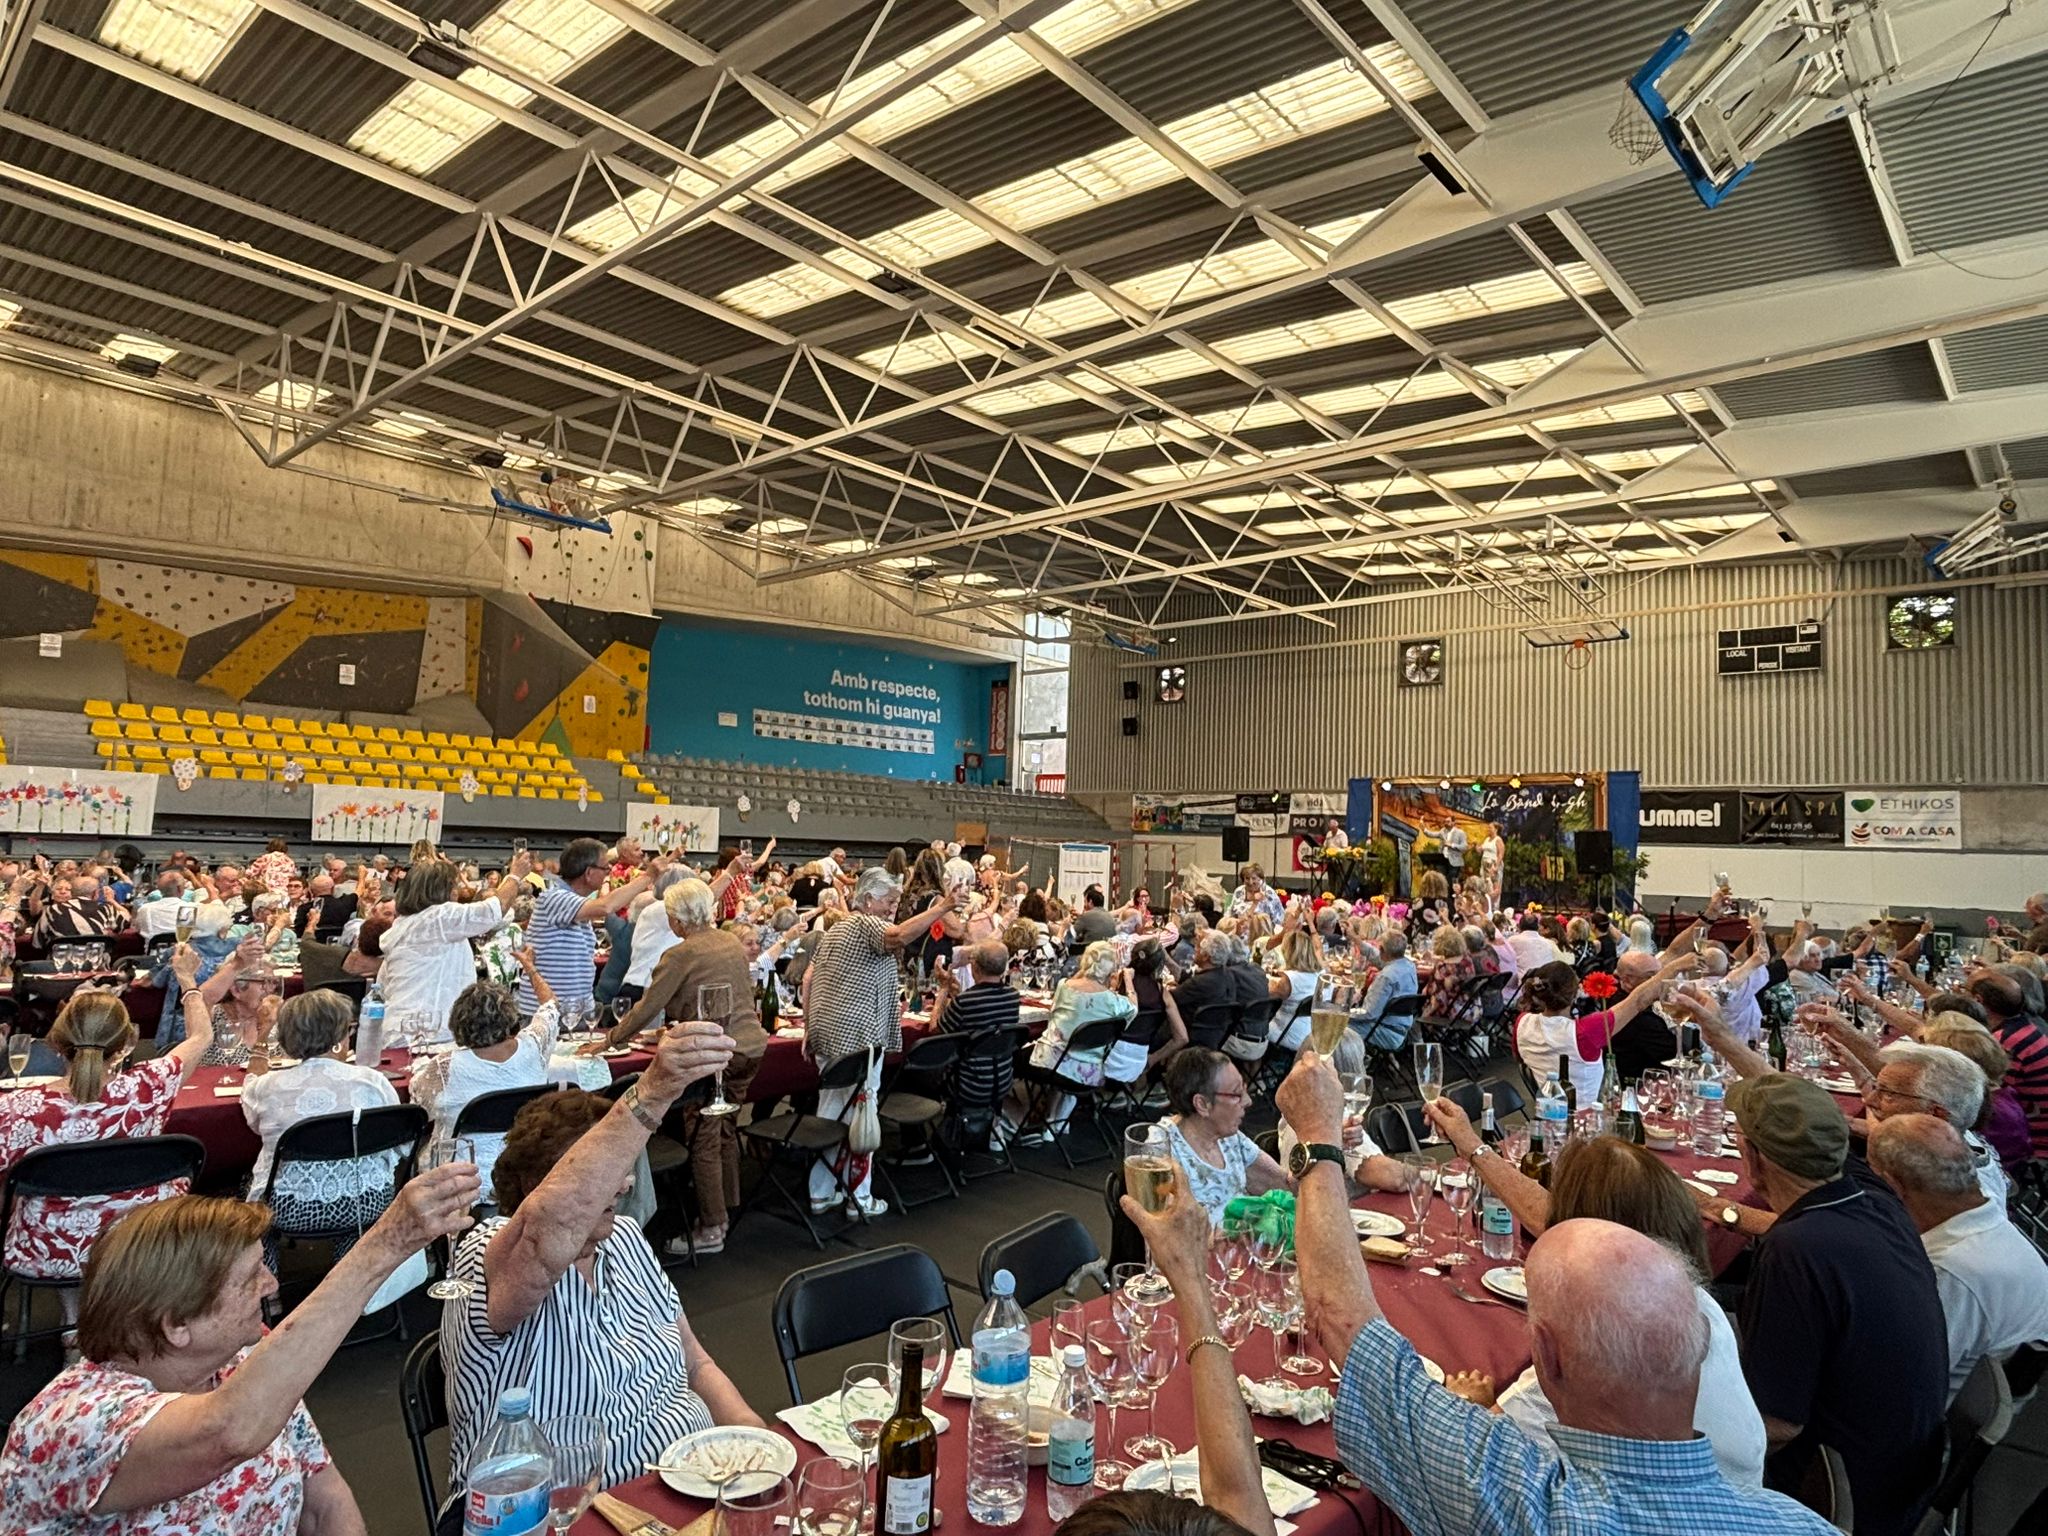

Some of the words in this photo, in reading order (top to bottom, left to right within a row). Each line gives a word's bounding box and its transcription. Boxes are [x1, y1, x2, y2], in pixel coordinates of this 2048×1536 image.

[1726, 649, 1748, 658] LOCAL
[831, 669, 869, 690] Amb
[871, 679, 941, 703] respecte,
[803, 690, 863, 713] tothom
[865, 697, 881, 715] hi
[883, 704, 941, 724] guanya!
[1747, 801, 1788, 816] TALA
[1805, 801, 1838, 816] SPA
[1880, 798, 1955, 810] ETHIKOS
[1639, 802, 1721, 827] ummel
[1873, 826, 1903, 836] COM
[1906, 826, 1916, 836] A
[1919, 826, 1956, 836] CASA
